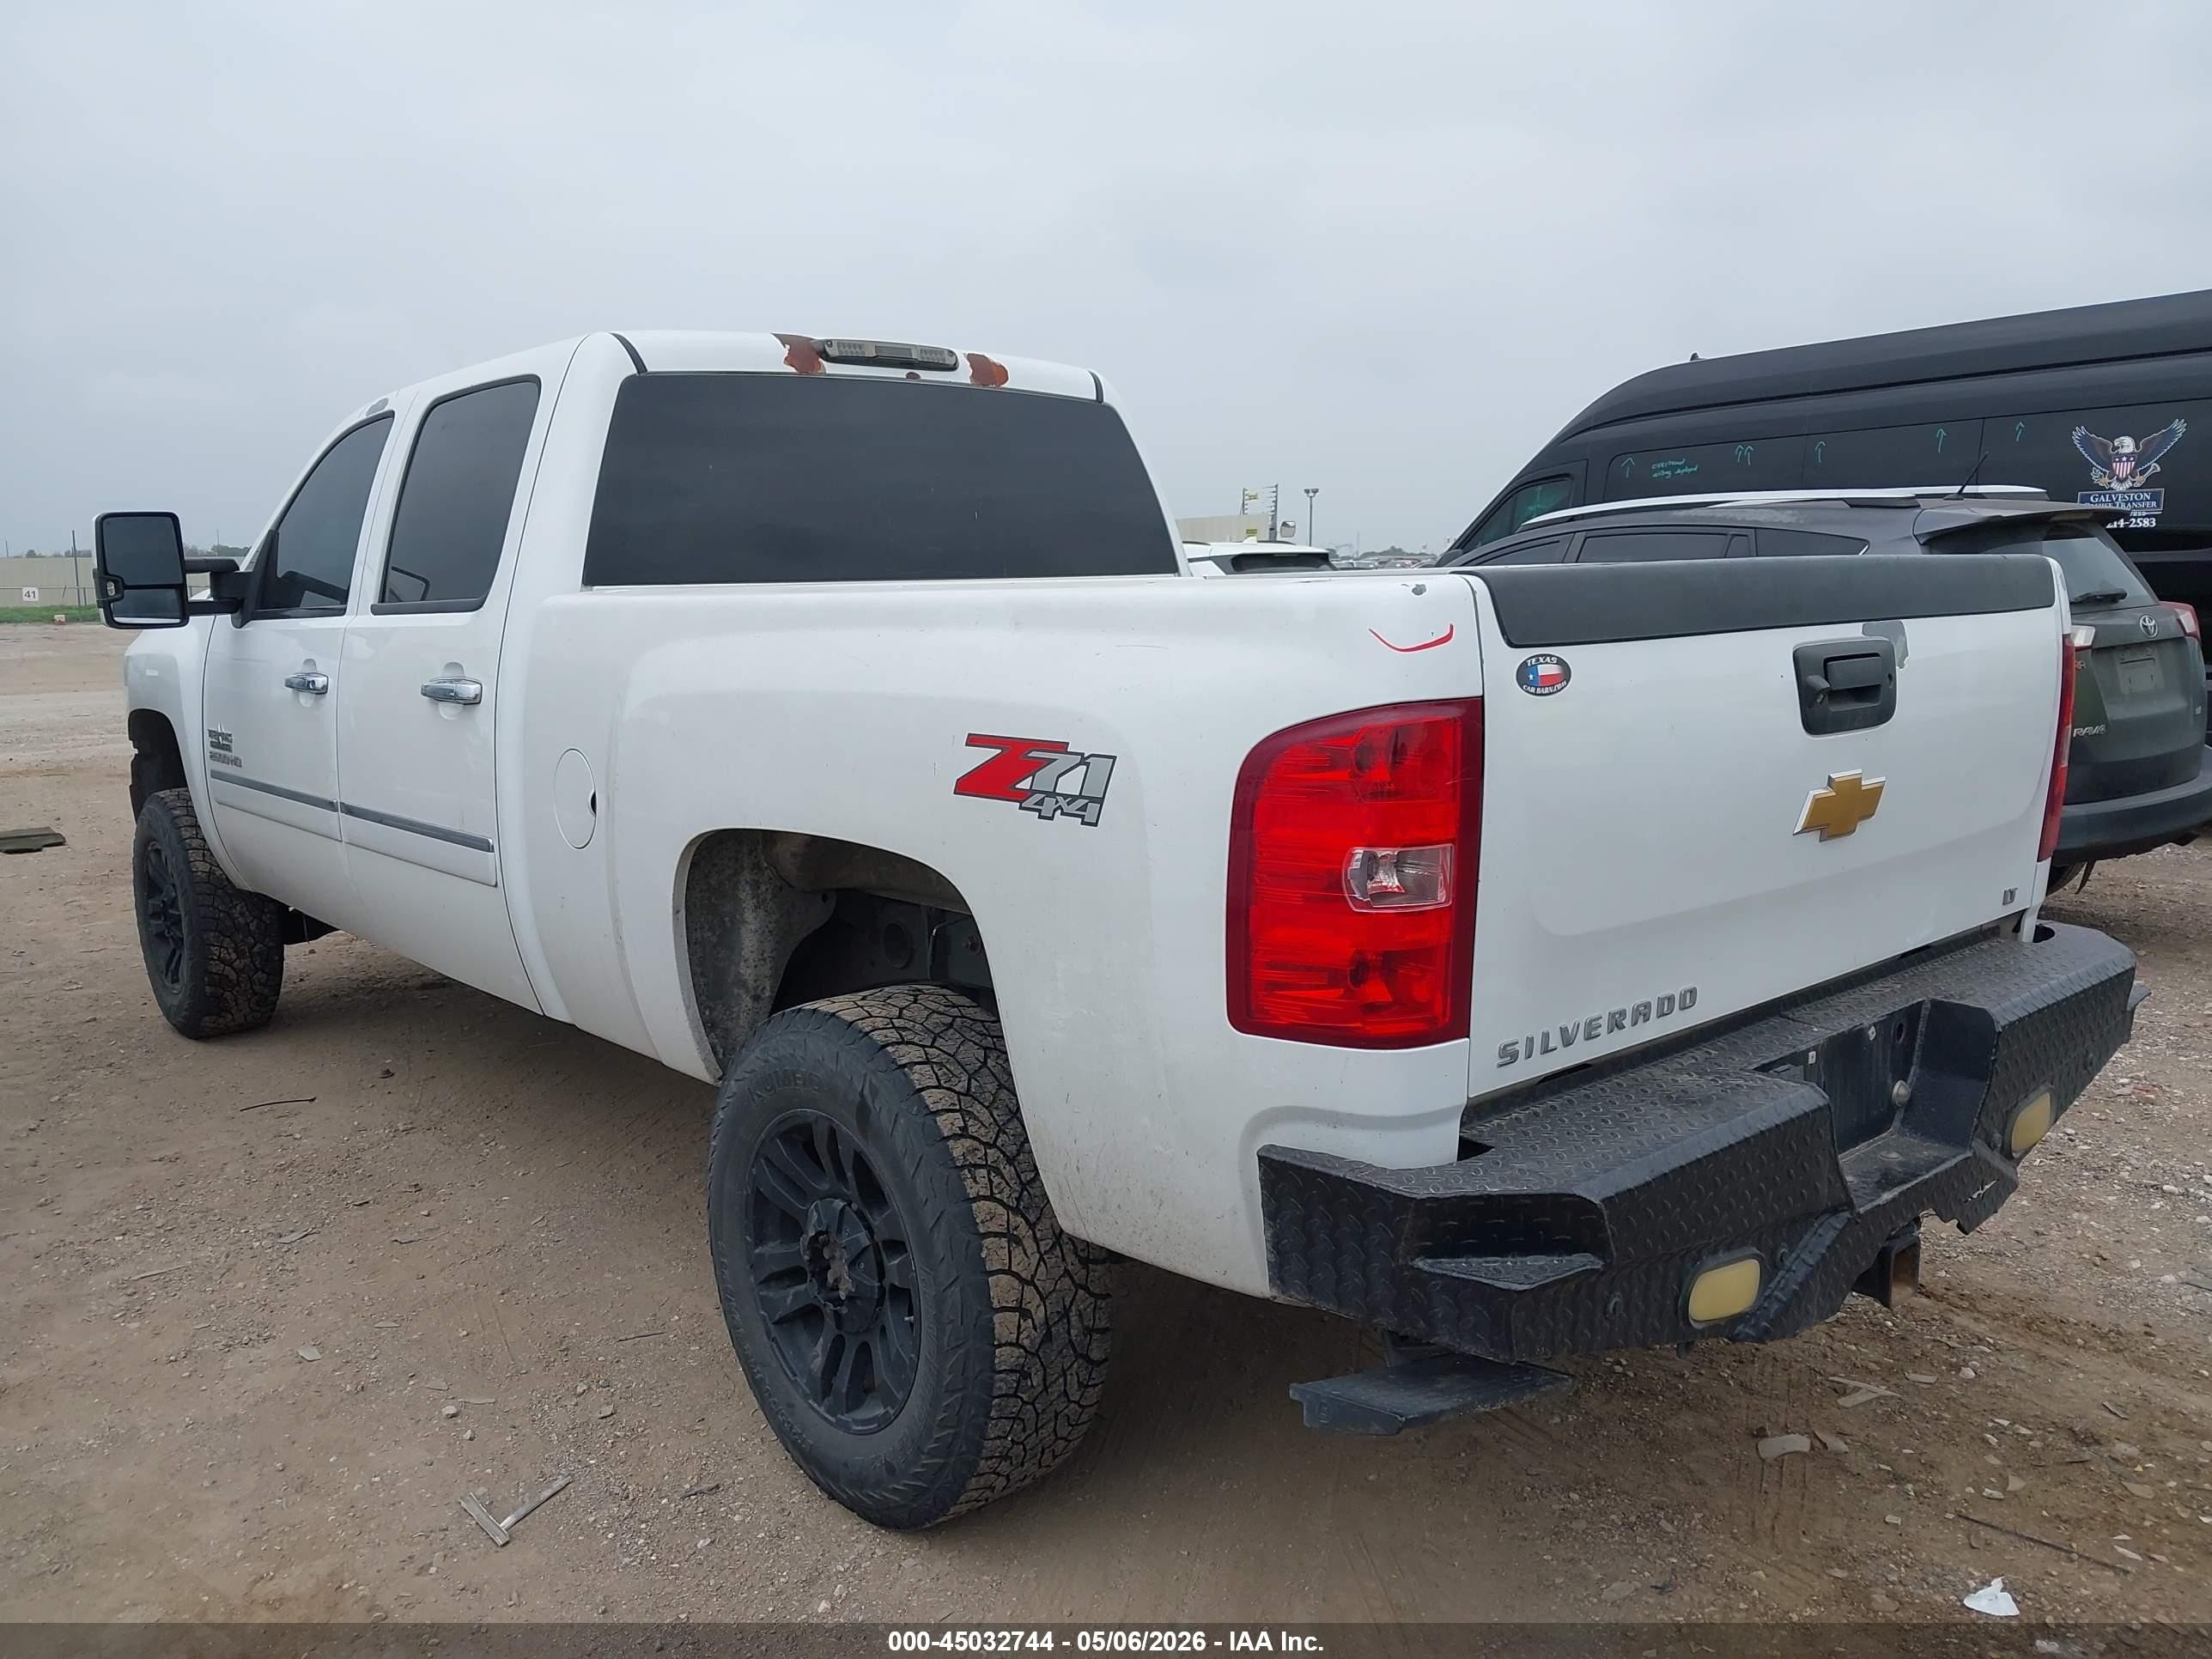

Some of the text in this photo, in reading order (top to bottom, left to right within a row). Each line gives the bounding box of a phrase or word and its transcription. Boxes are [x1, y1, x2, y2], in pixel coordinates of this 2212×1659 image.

[2089, 492, 2151, 503] GALVESTON
[2114, 501, 2157, 509] TRANSFER
[24, 590, 36, 599] 41
[1526, 656, 1558, 667] TEXAS
[1522, 684, 1535, 695] CAR
[2073, 725, 2106, 738] RAV4
[953, 732, 1117, 804] Z71
[1496, 986, 1698, 1068] SILVERADO
